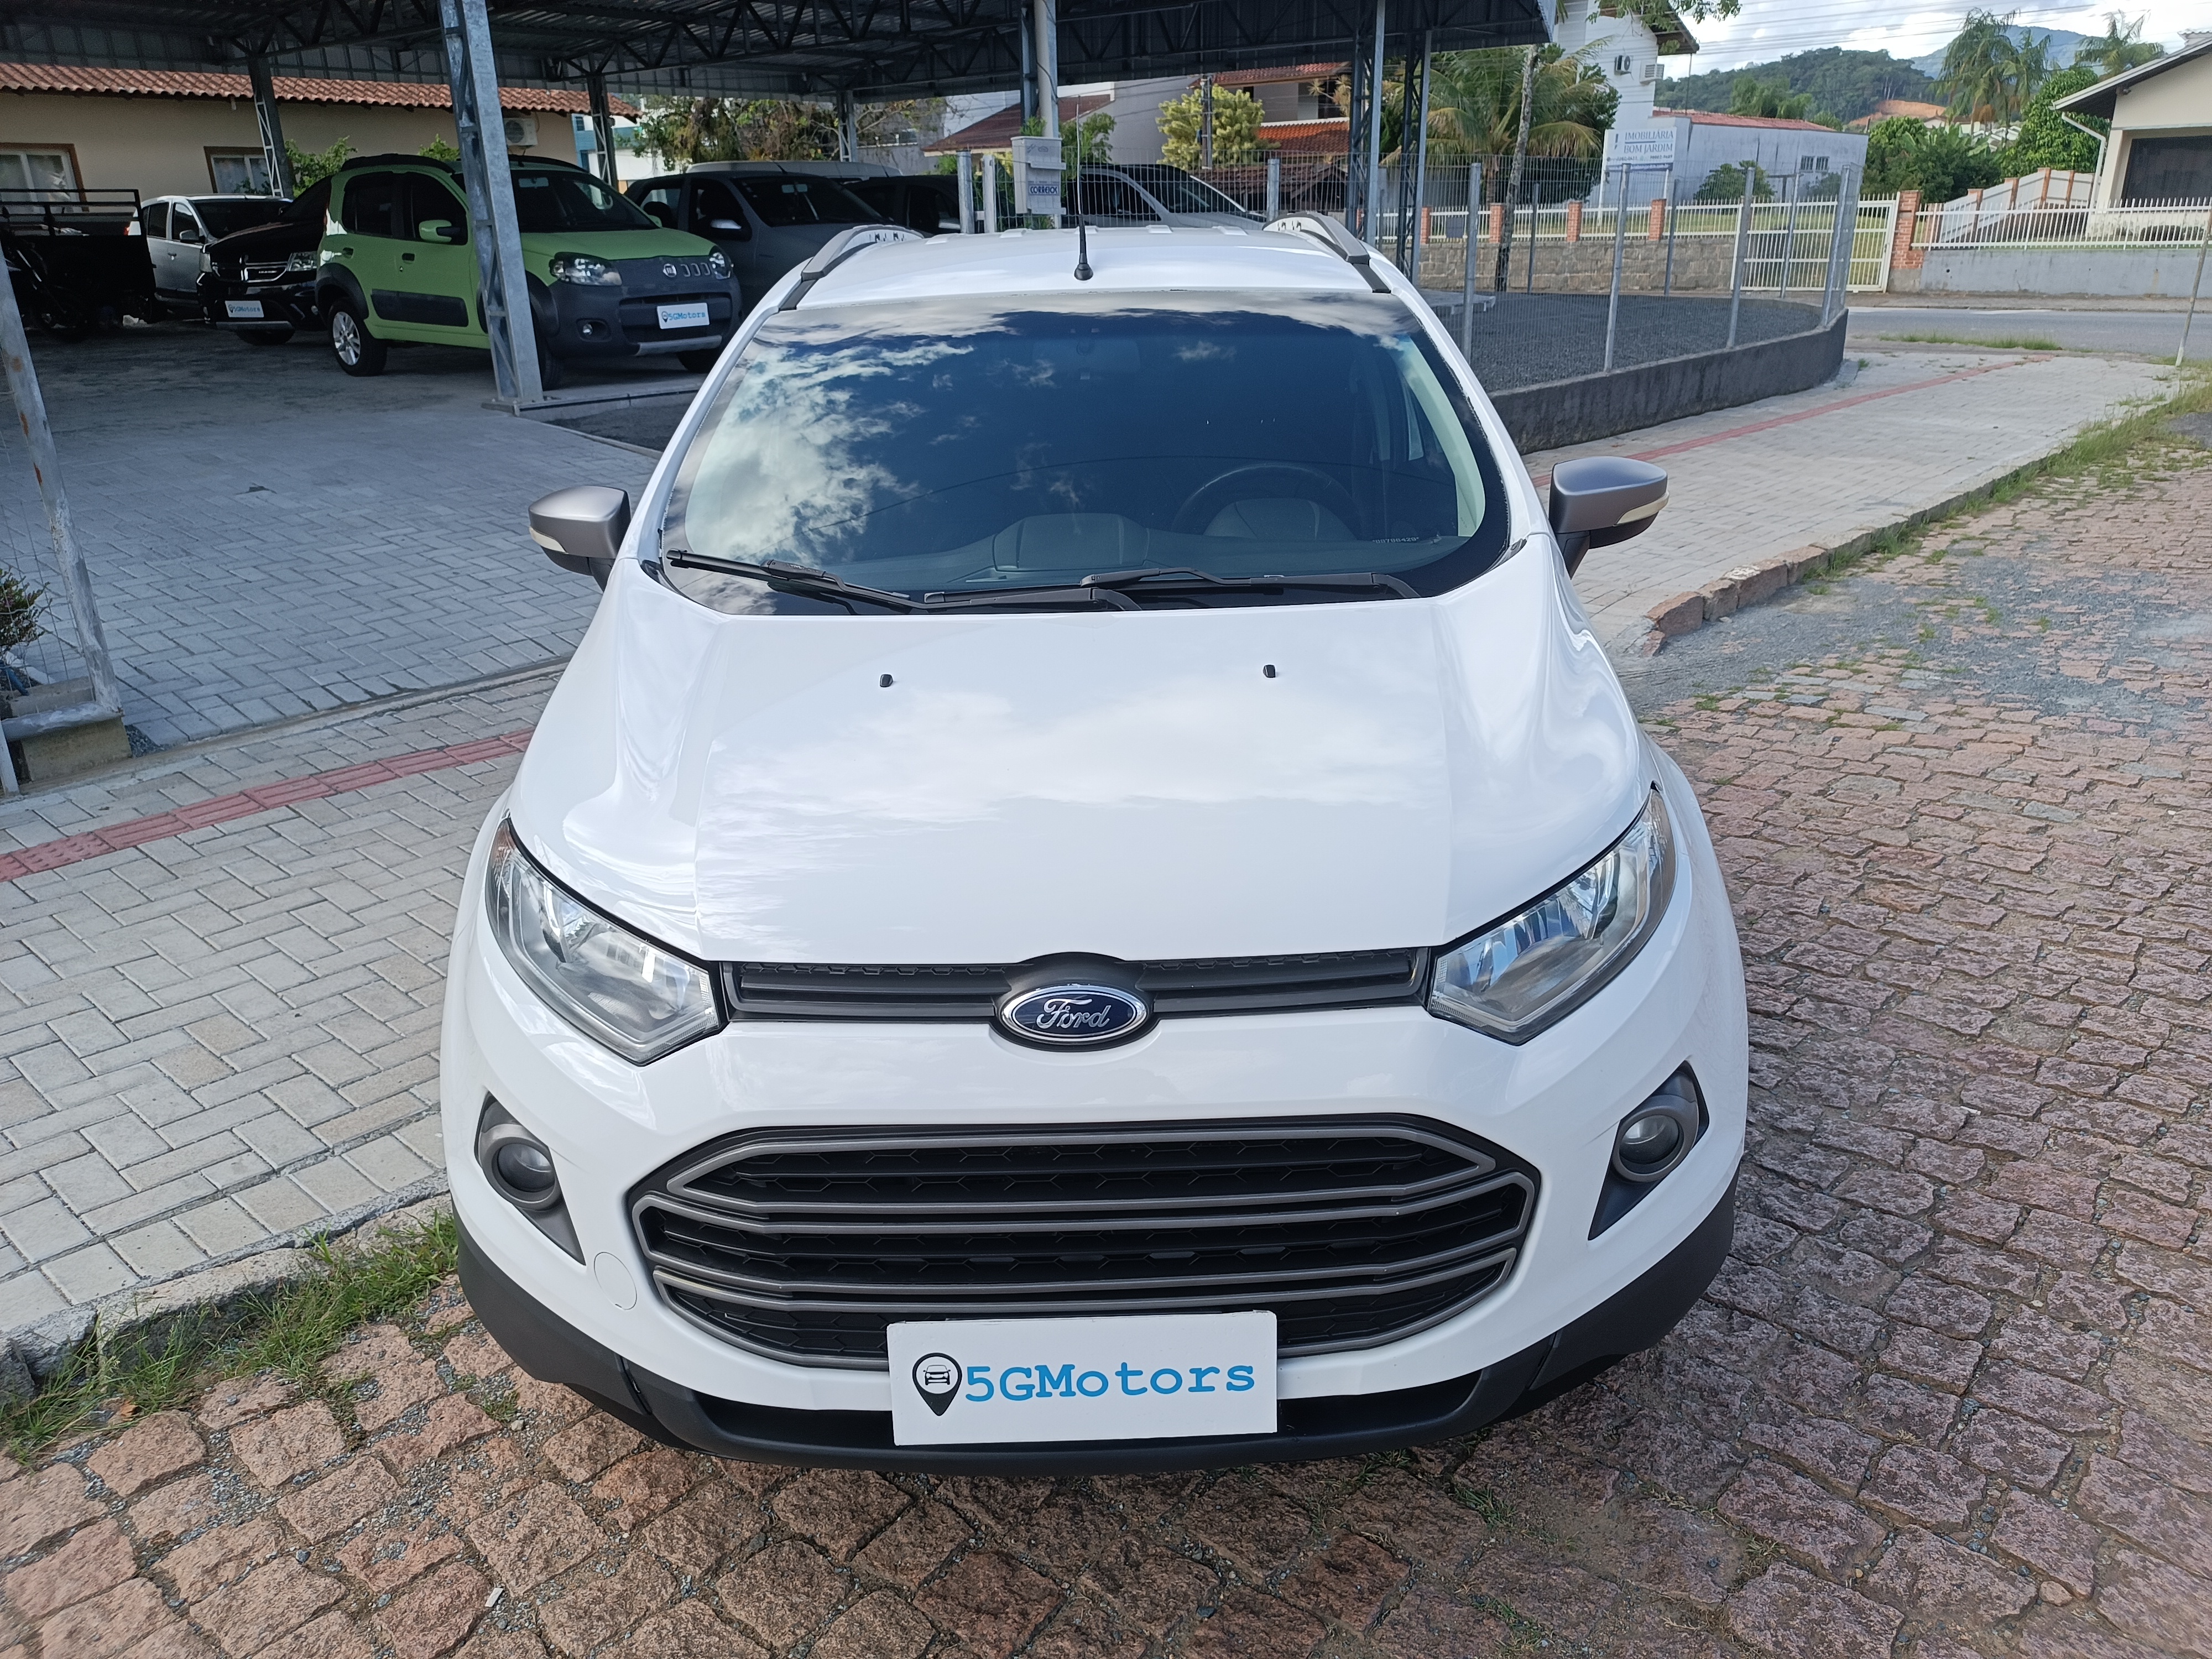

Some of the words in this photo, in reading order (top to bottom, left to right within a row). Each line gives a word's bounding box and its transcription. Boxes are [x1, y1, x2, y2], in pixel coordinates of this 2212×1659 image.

[1625, 128, 1674, 140] IMOBILIÁRIA
[1624, 144, 1642, 154] BOM
[1644, 143, 1673, 154] JARDIM
[668, 311, 706, 321] 5GMotors
[1036, 998, 1112, 1029] Ford
[965, 1361, 1255, 1402] 5GMotors
